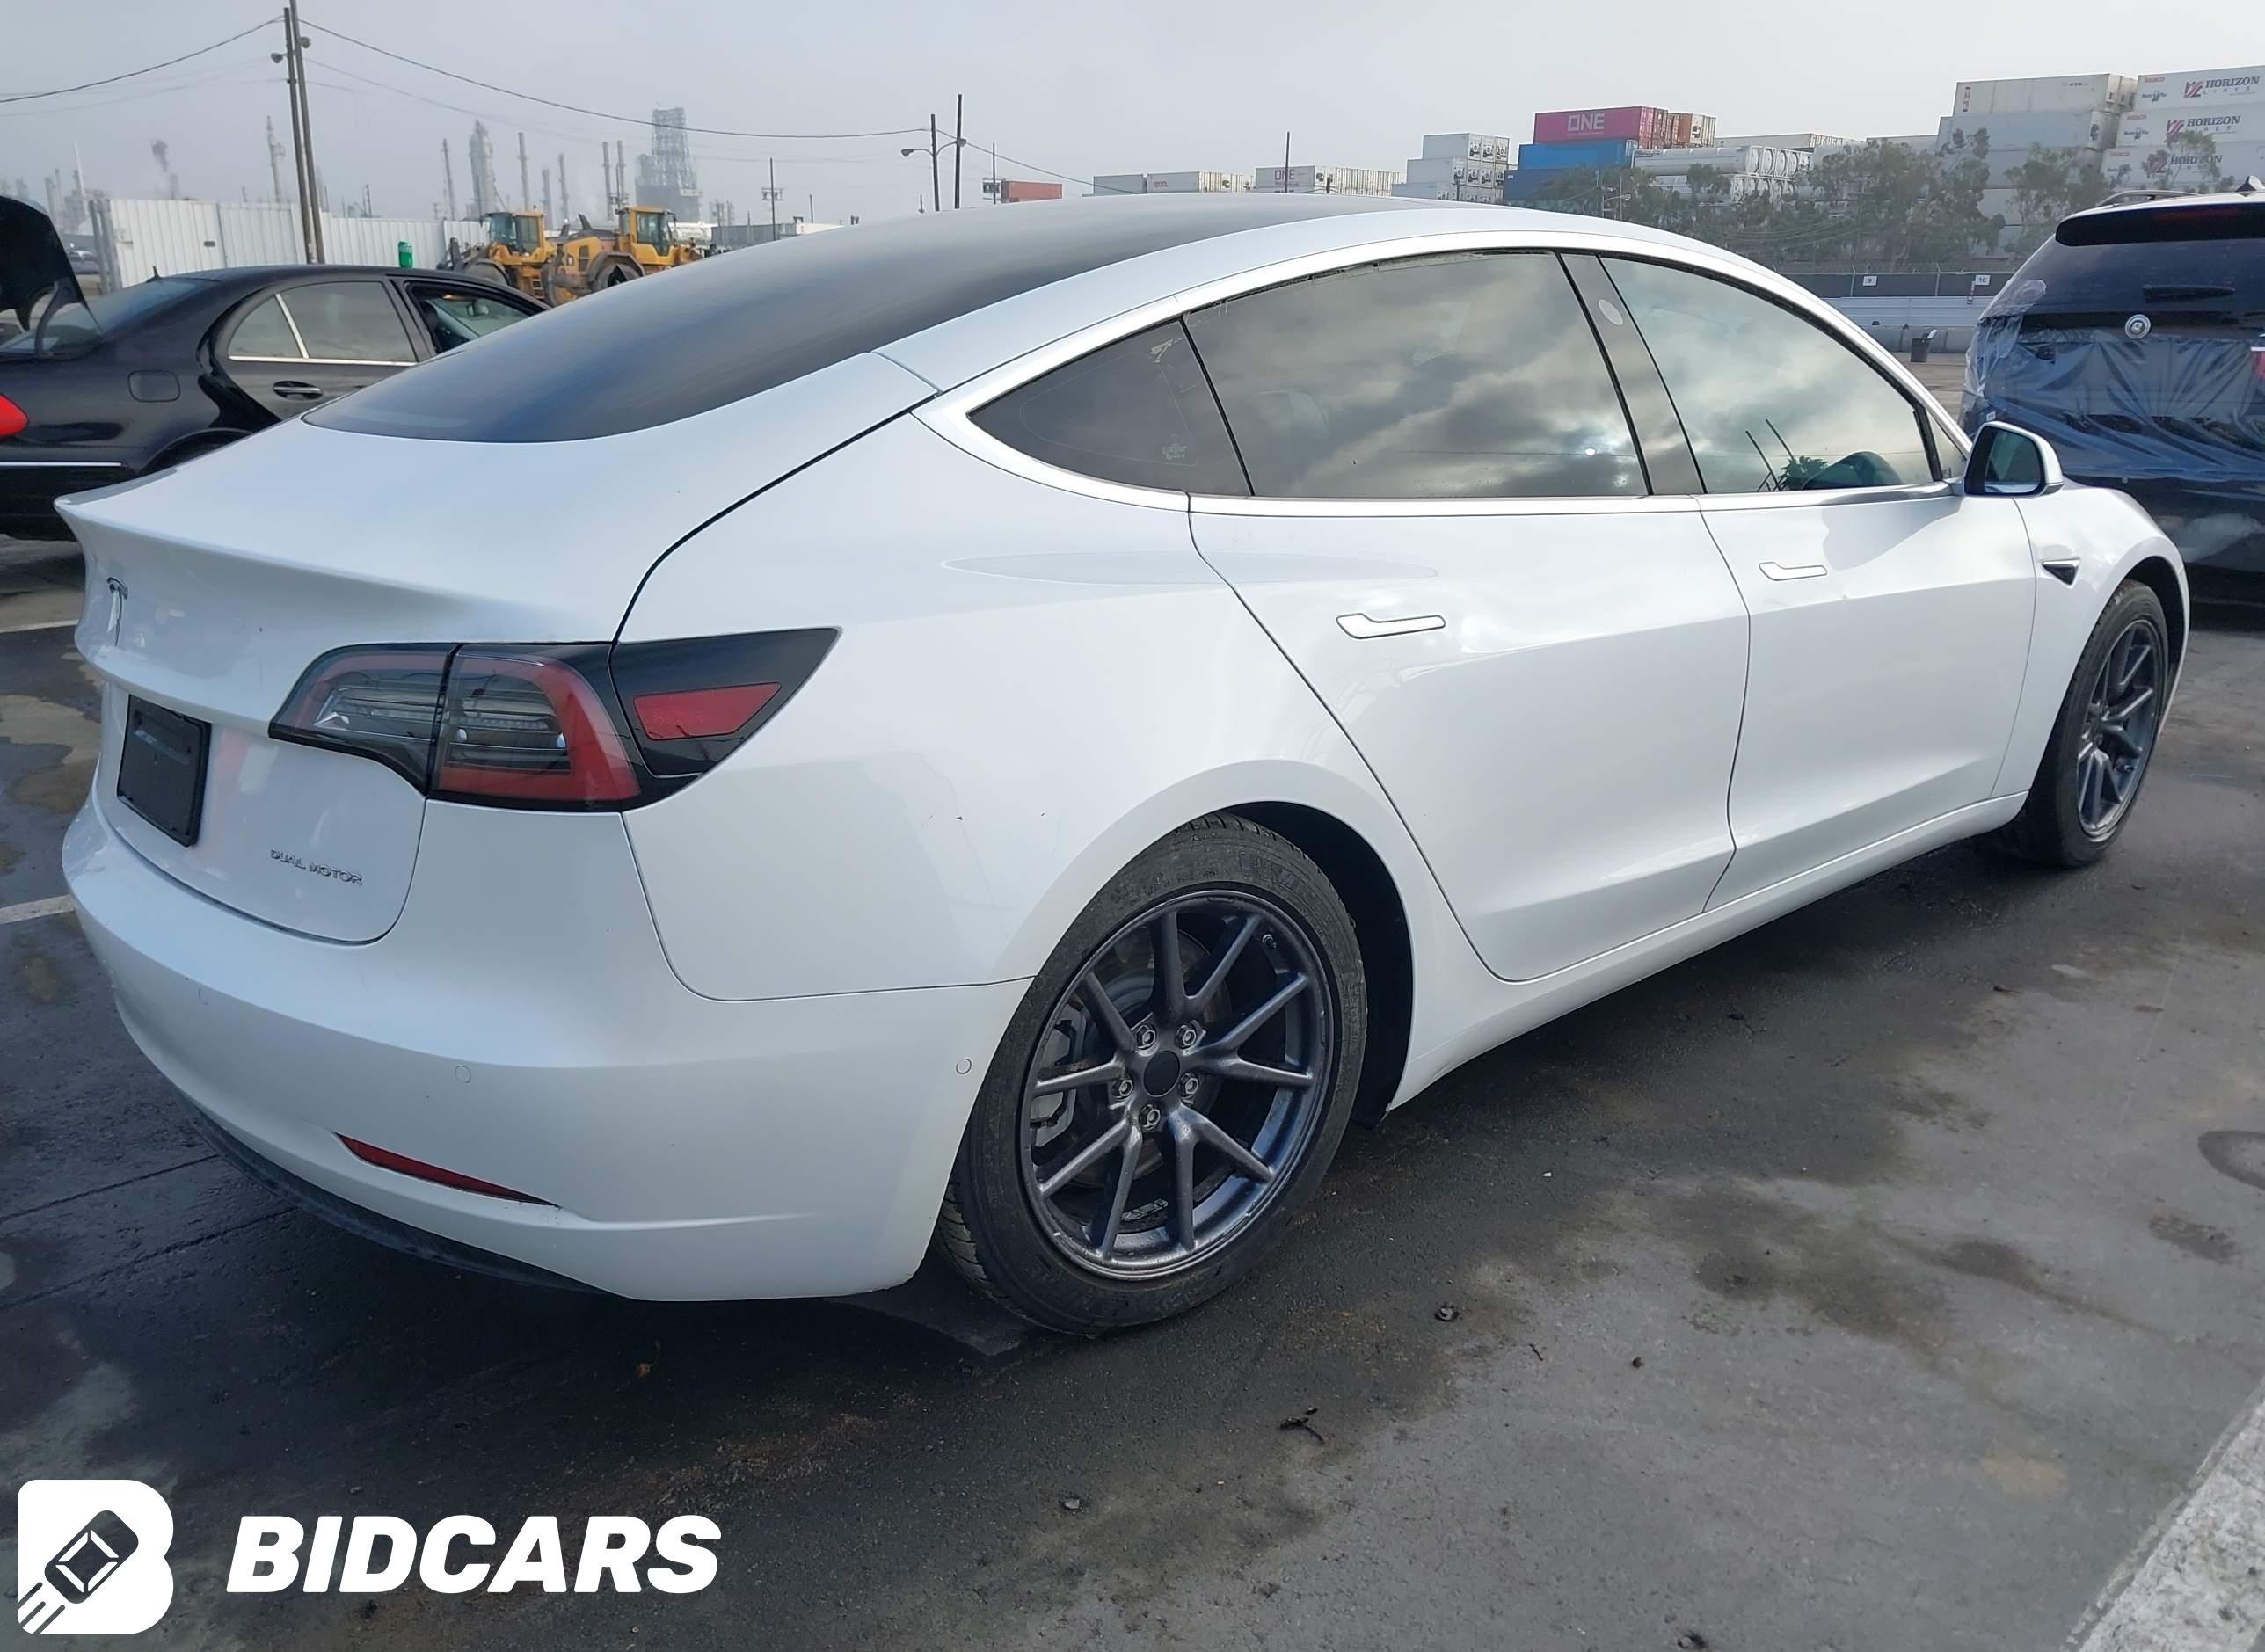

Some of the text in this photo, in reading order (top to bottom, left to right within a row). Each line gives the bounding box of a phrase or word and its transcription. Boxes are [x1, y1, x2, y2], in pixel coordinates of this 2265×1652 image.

[2205, 76, 2261, 88] HORIZON
[1568, 113, 1605, 132] ONE
[2186, 115, 2241, 127] HORIZON
[271, 849, 363, 885] DUAL MOTOR
